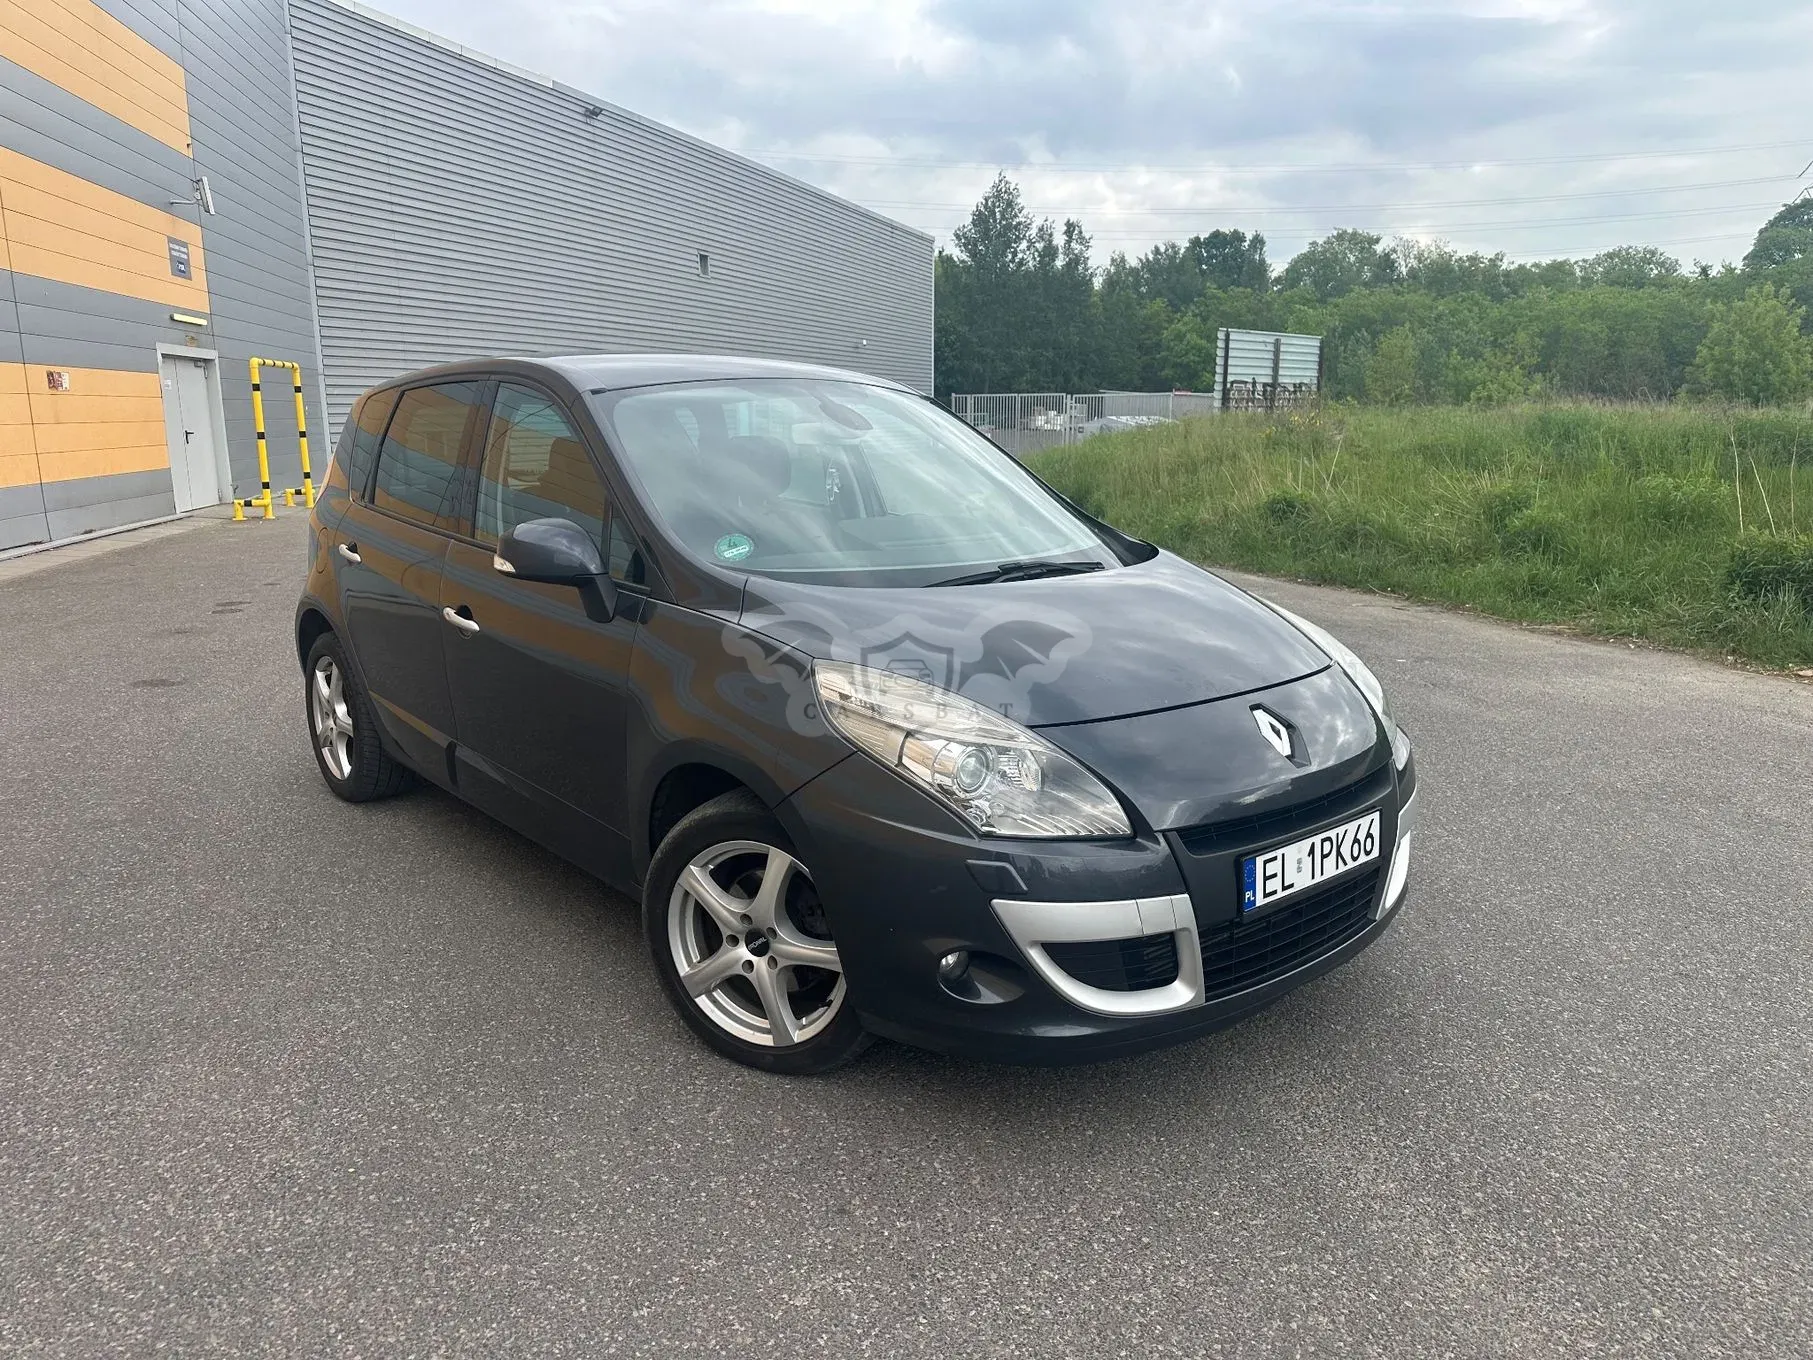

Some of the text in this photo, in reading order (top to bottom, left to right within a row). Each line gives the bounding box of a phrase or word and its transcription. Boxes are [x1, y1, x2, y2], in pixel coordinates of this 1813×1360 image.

[1262, 818, 1375, 899] EL 1PK66
[1245, 891, 1255, 903] PL
